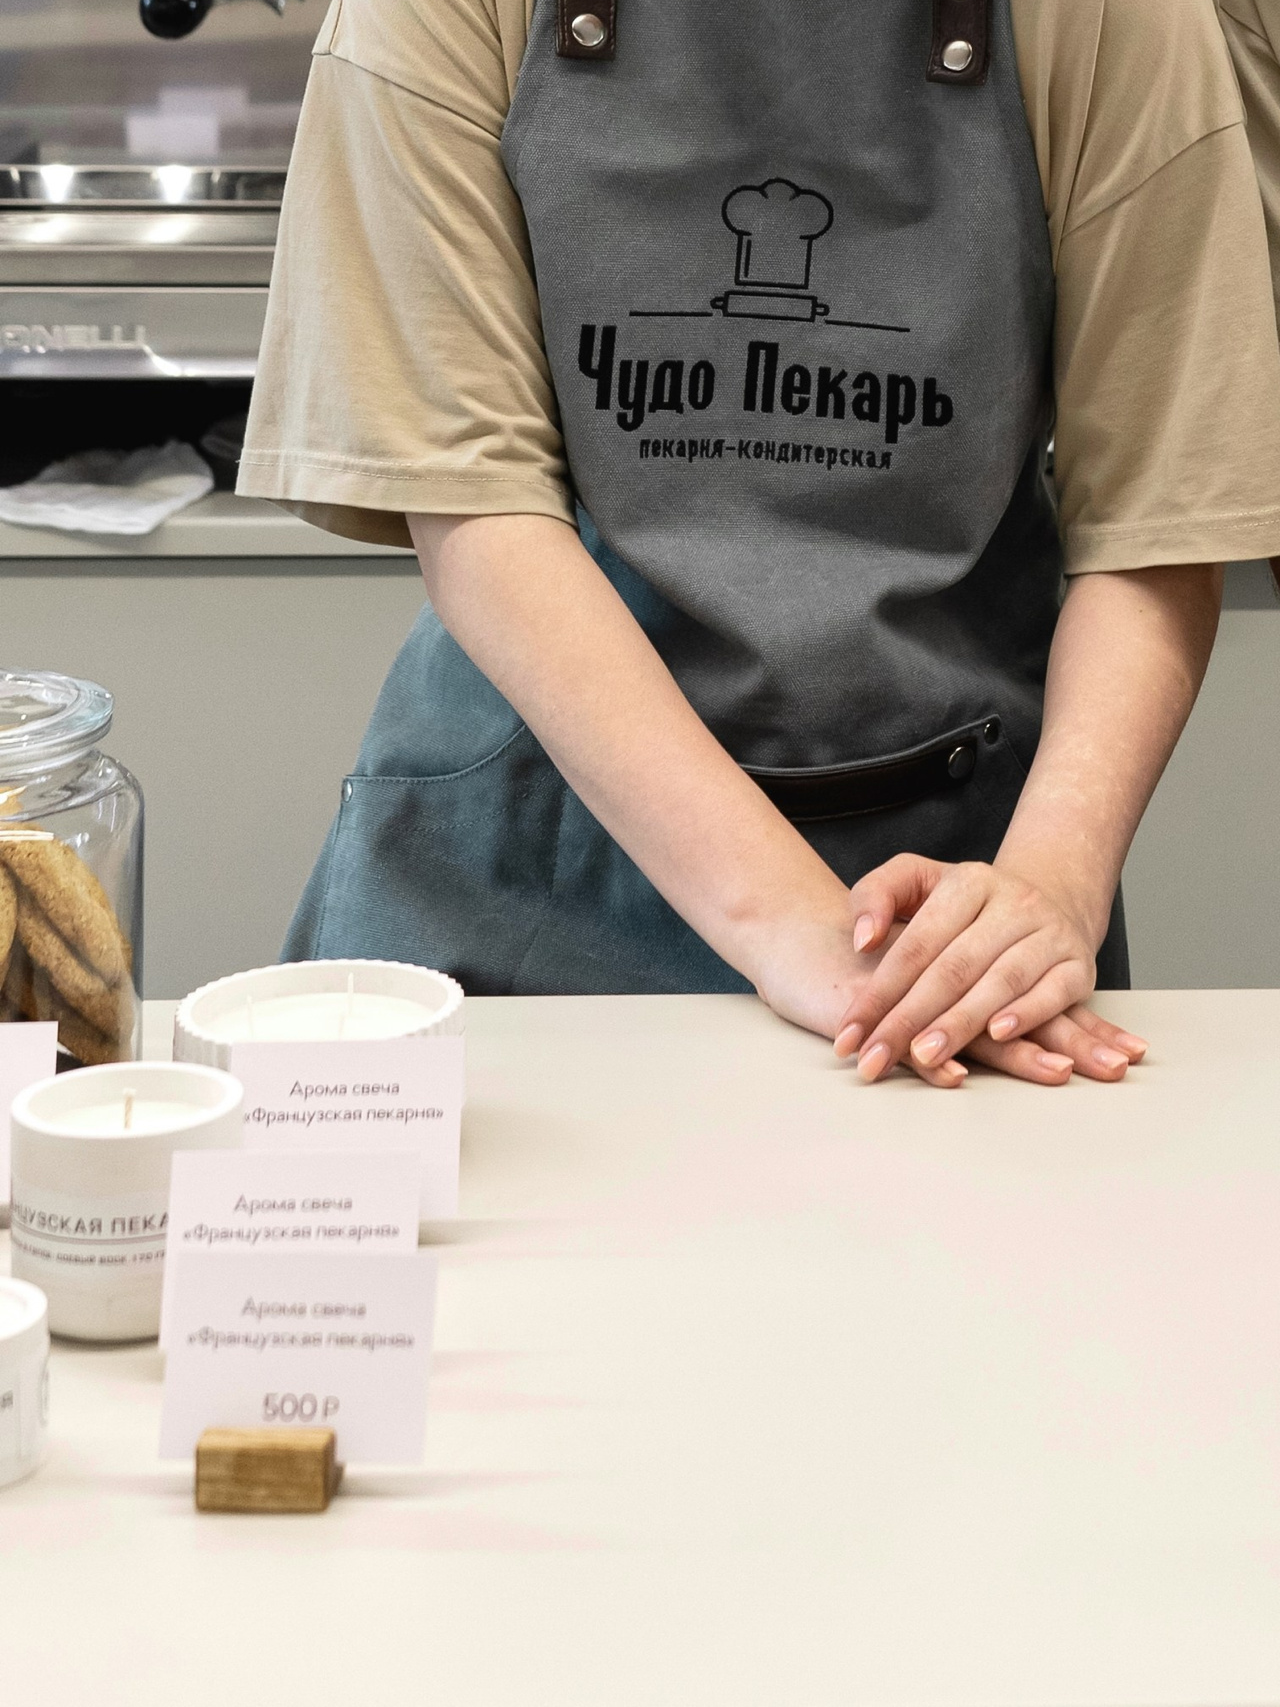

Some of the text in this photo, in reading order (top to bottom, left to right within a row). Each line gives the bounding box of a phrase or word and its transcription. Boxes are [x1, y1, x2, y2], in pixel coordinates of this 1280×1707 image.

[0, 324, 147, 353] ONELLI
[577, 324, 953, 444] Чудо Пекарь
[639, 438, 892, 470] пекарня-кондитерская
[289, 1080, 400, 1101] Арома свеча
[233, 1194, 353, 1217] Арома свеча
